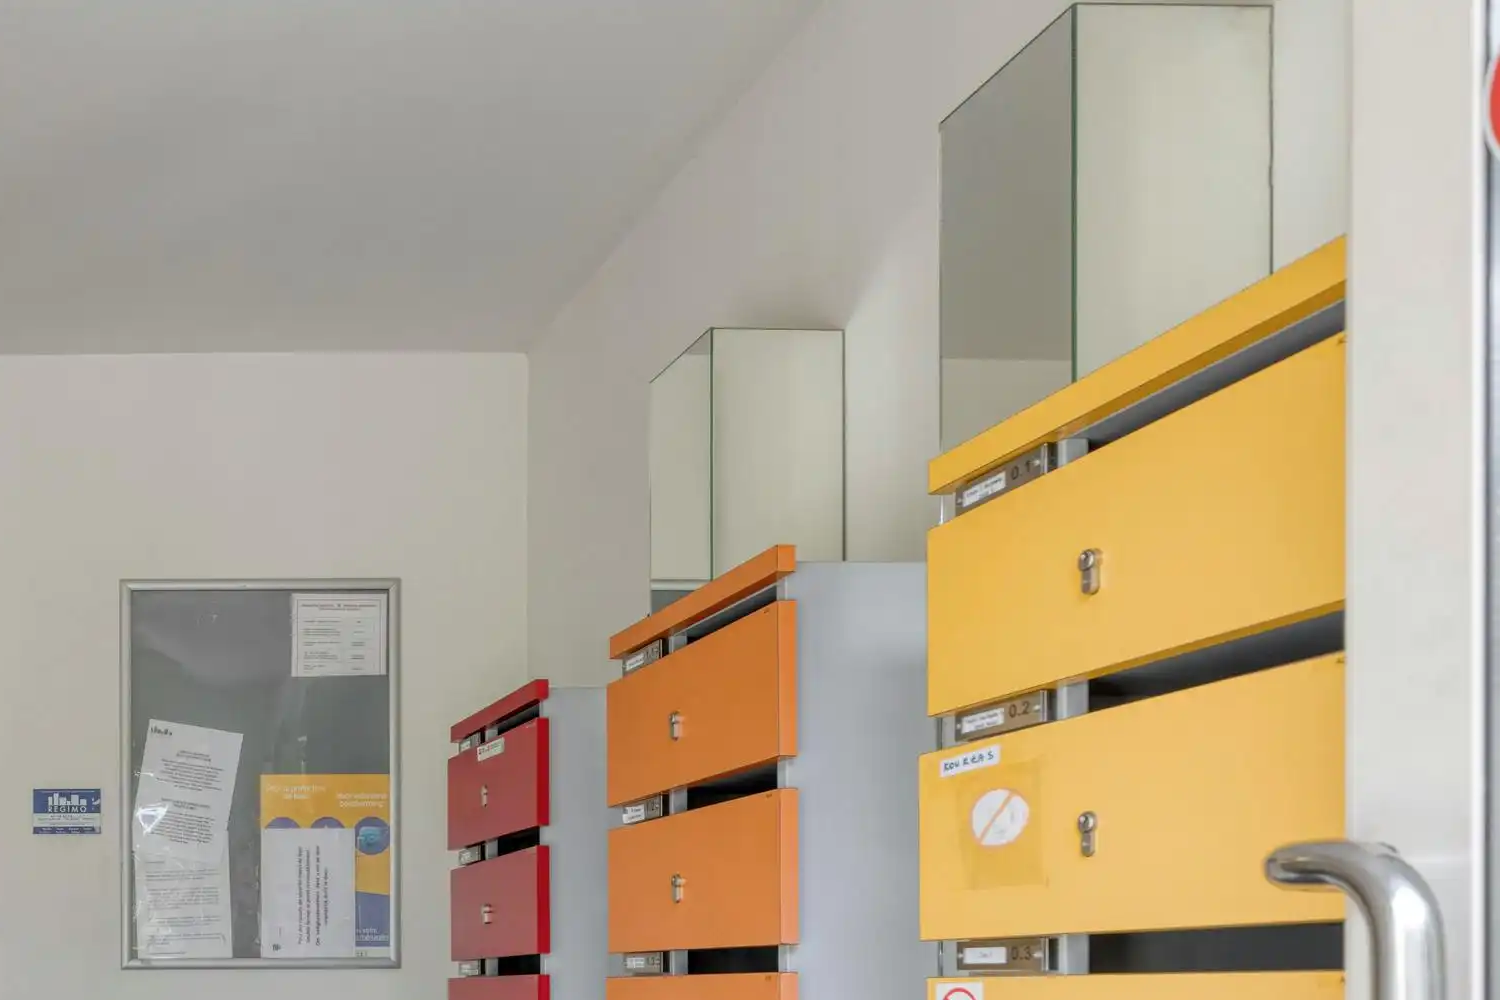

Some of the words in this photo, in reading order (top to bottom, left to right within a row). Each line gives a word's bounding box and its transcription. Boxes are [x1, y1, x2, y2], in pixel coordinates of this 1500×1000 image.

[1008, 701, 1030, 718] 0.2
[48, 805, 87, 813] REGIMO
[1011, 946, 1032, 961] 0.3
